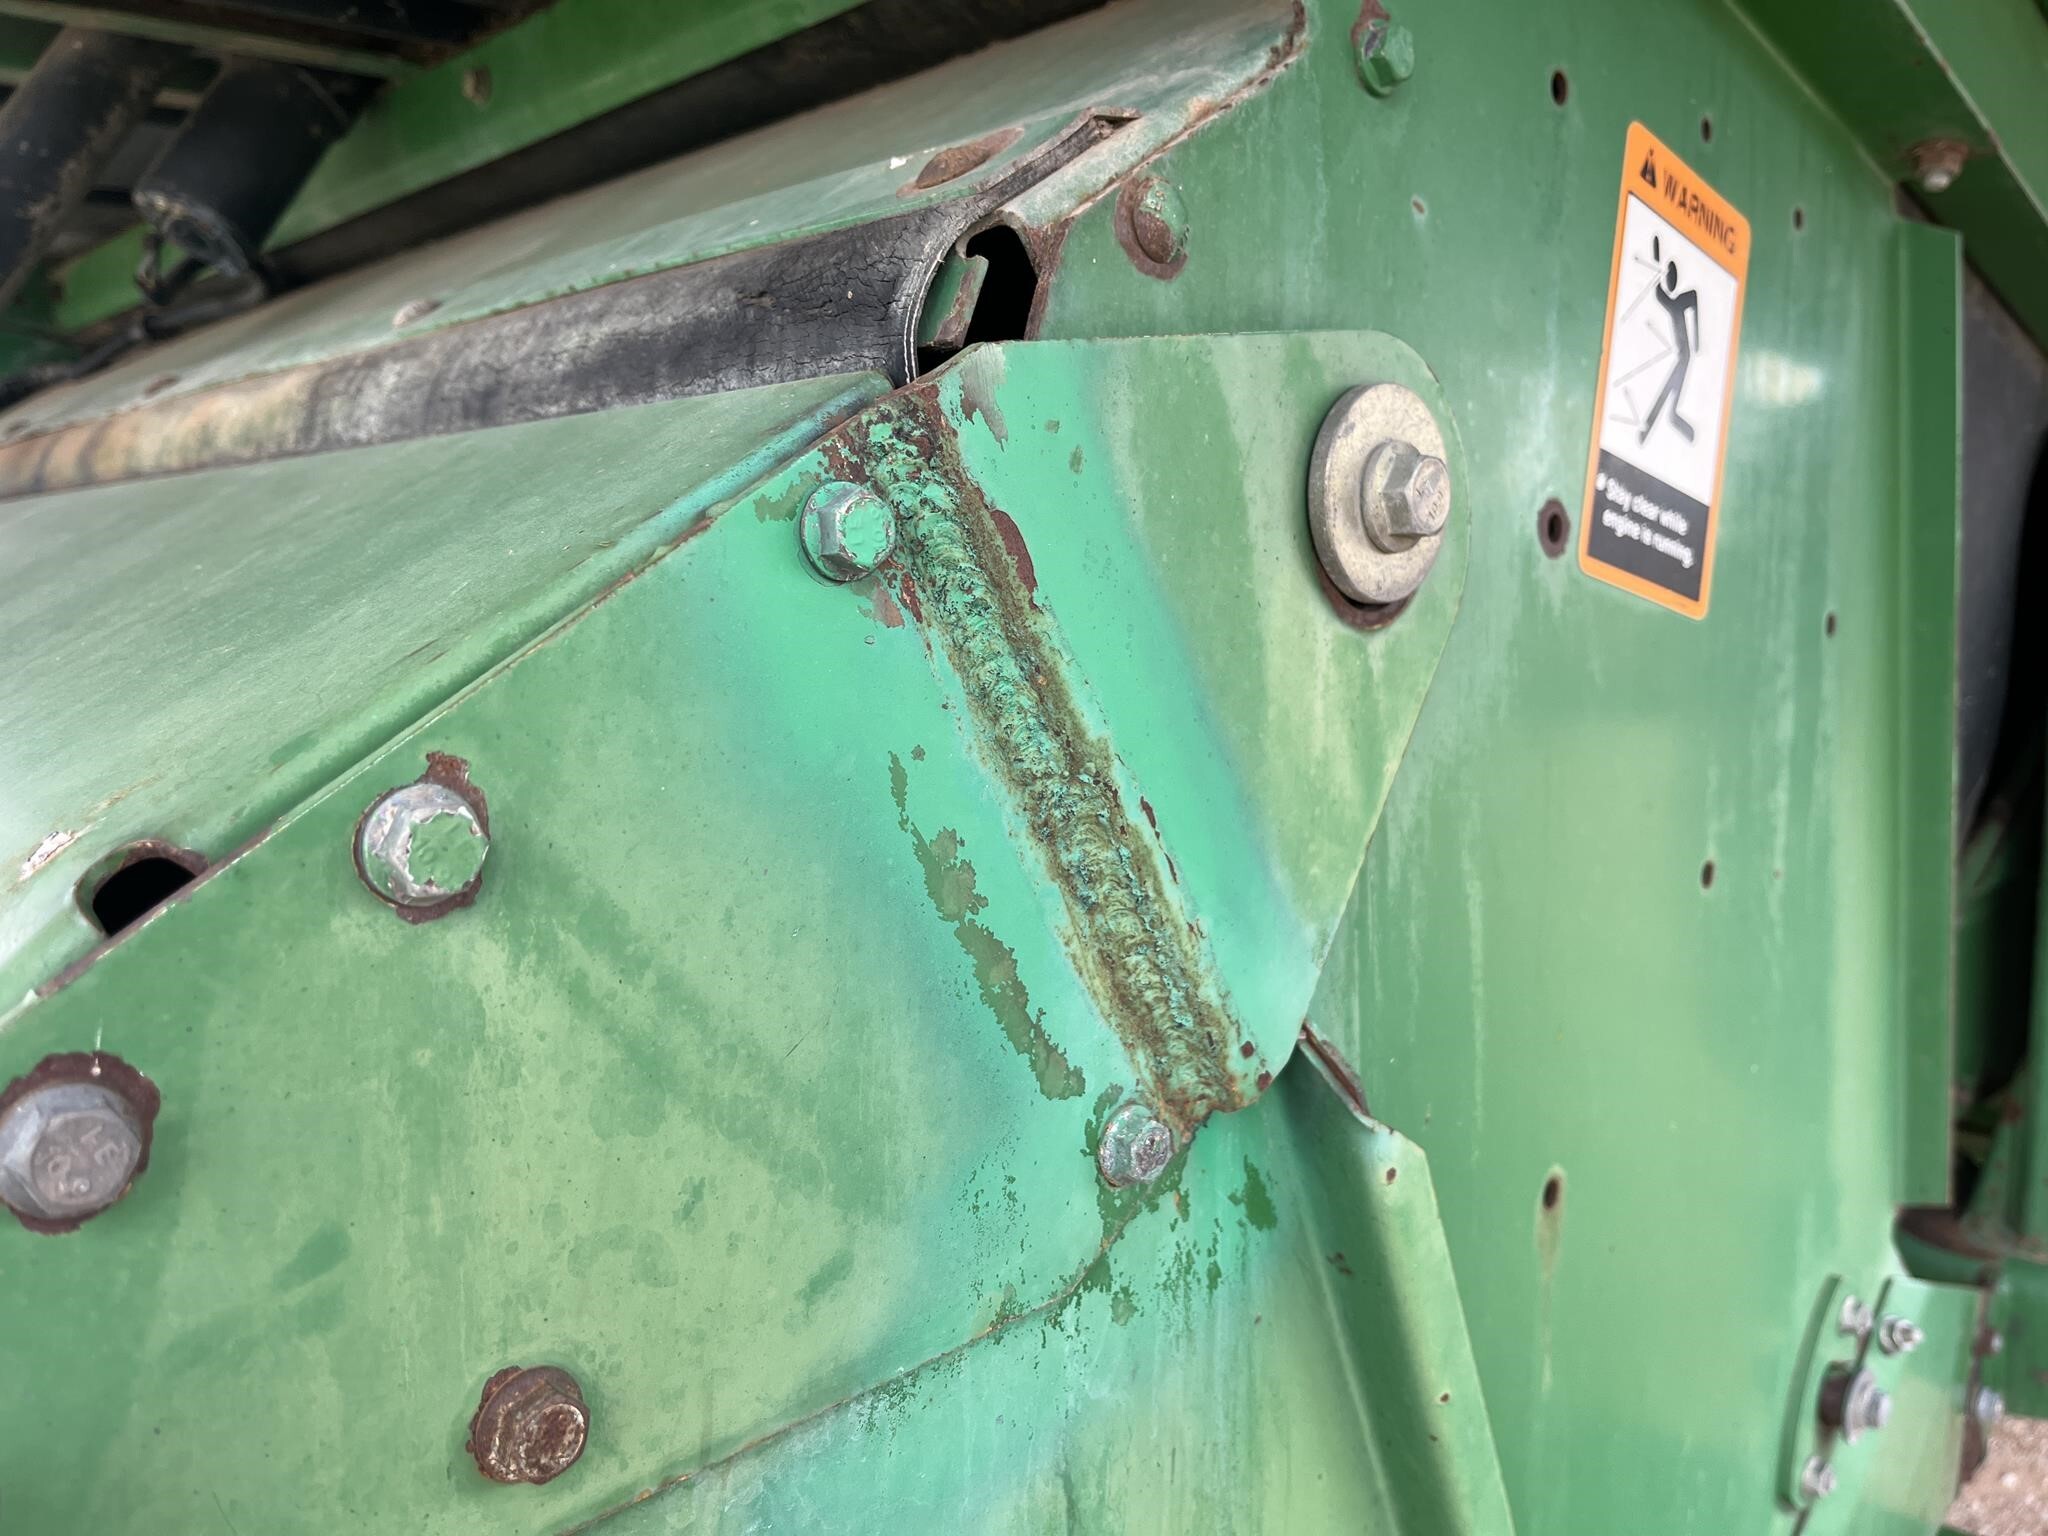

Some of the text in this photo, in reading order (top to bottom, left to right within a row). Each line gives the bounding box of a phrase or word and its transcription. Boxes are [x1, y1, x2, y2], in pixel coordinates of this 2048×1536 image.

[1664, 169, 1736, 254] WARNING
[1602, 508, 1641, 540] engine
[1605, 478, 1689, 537] Stay clear while
